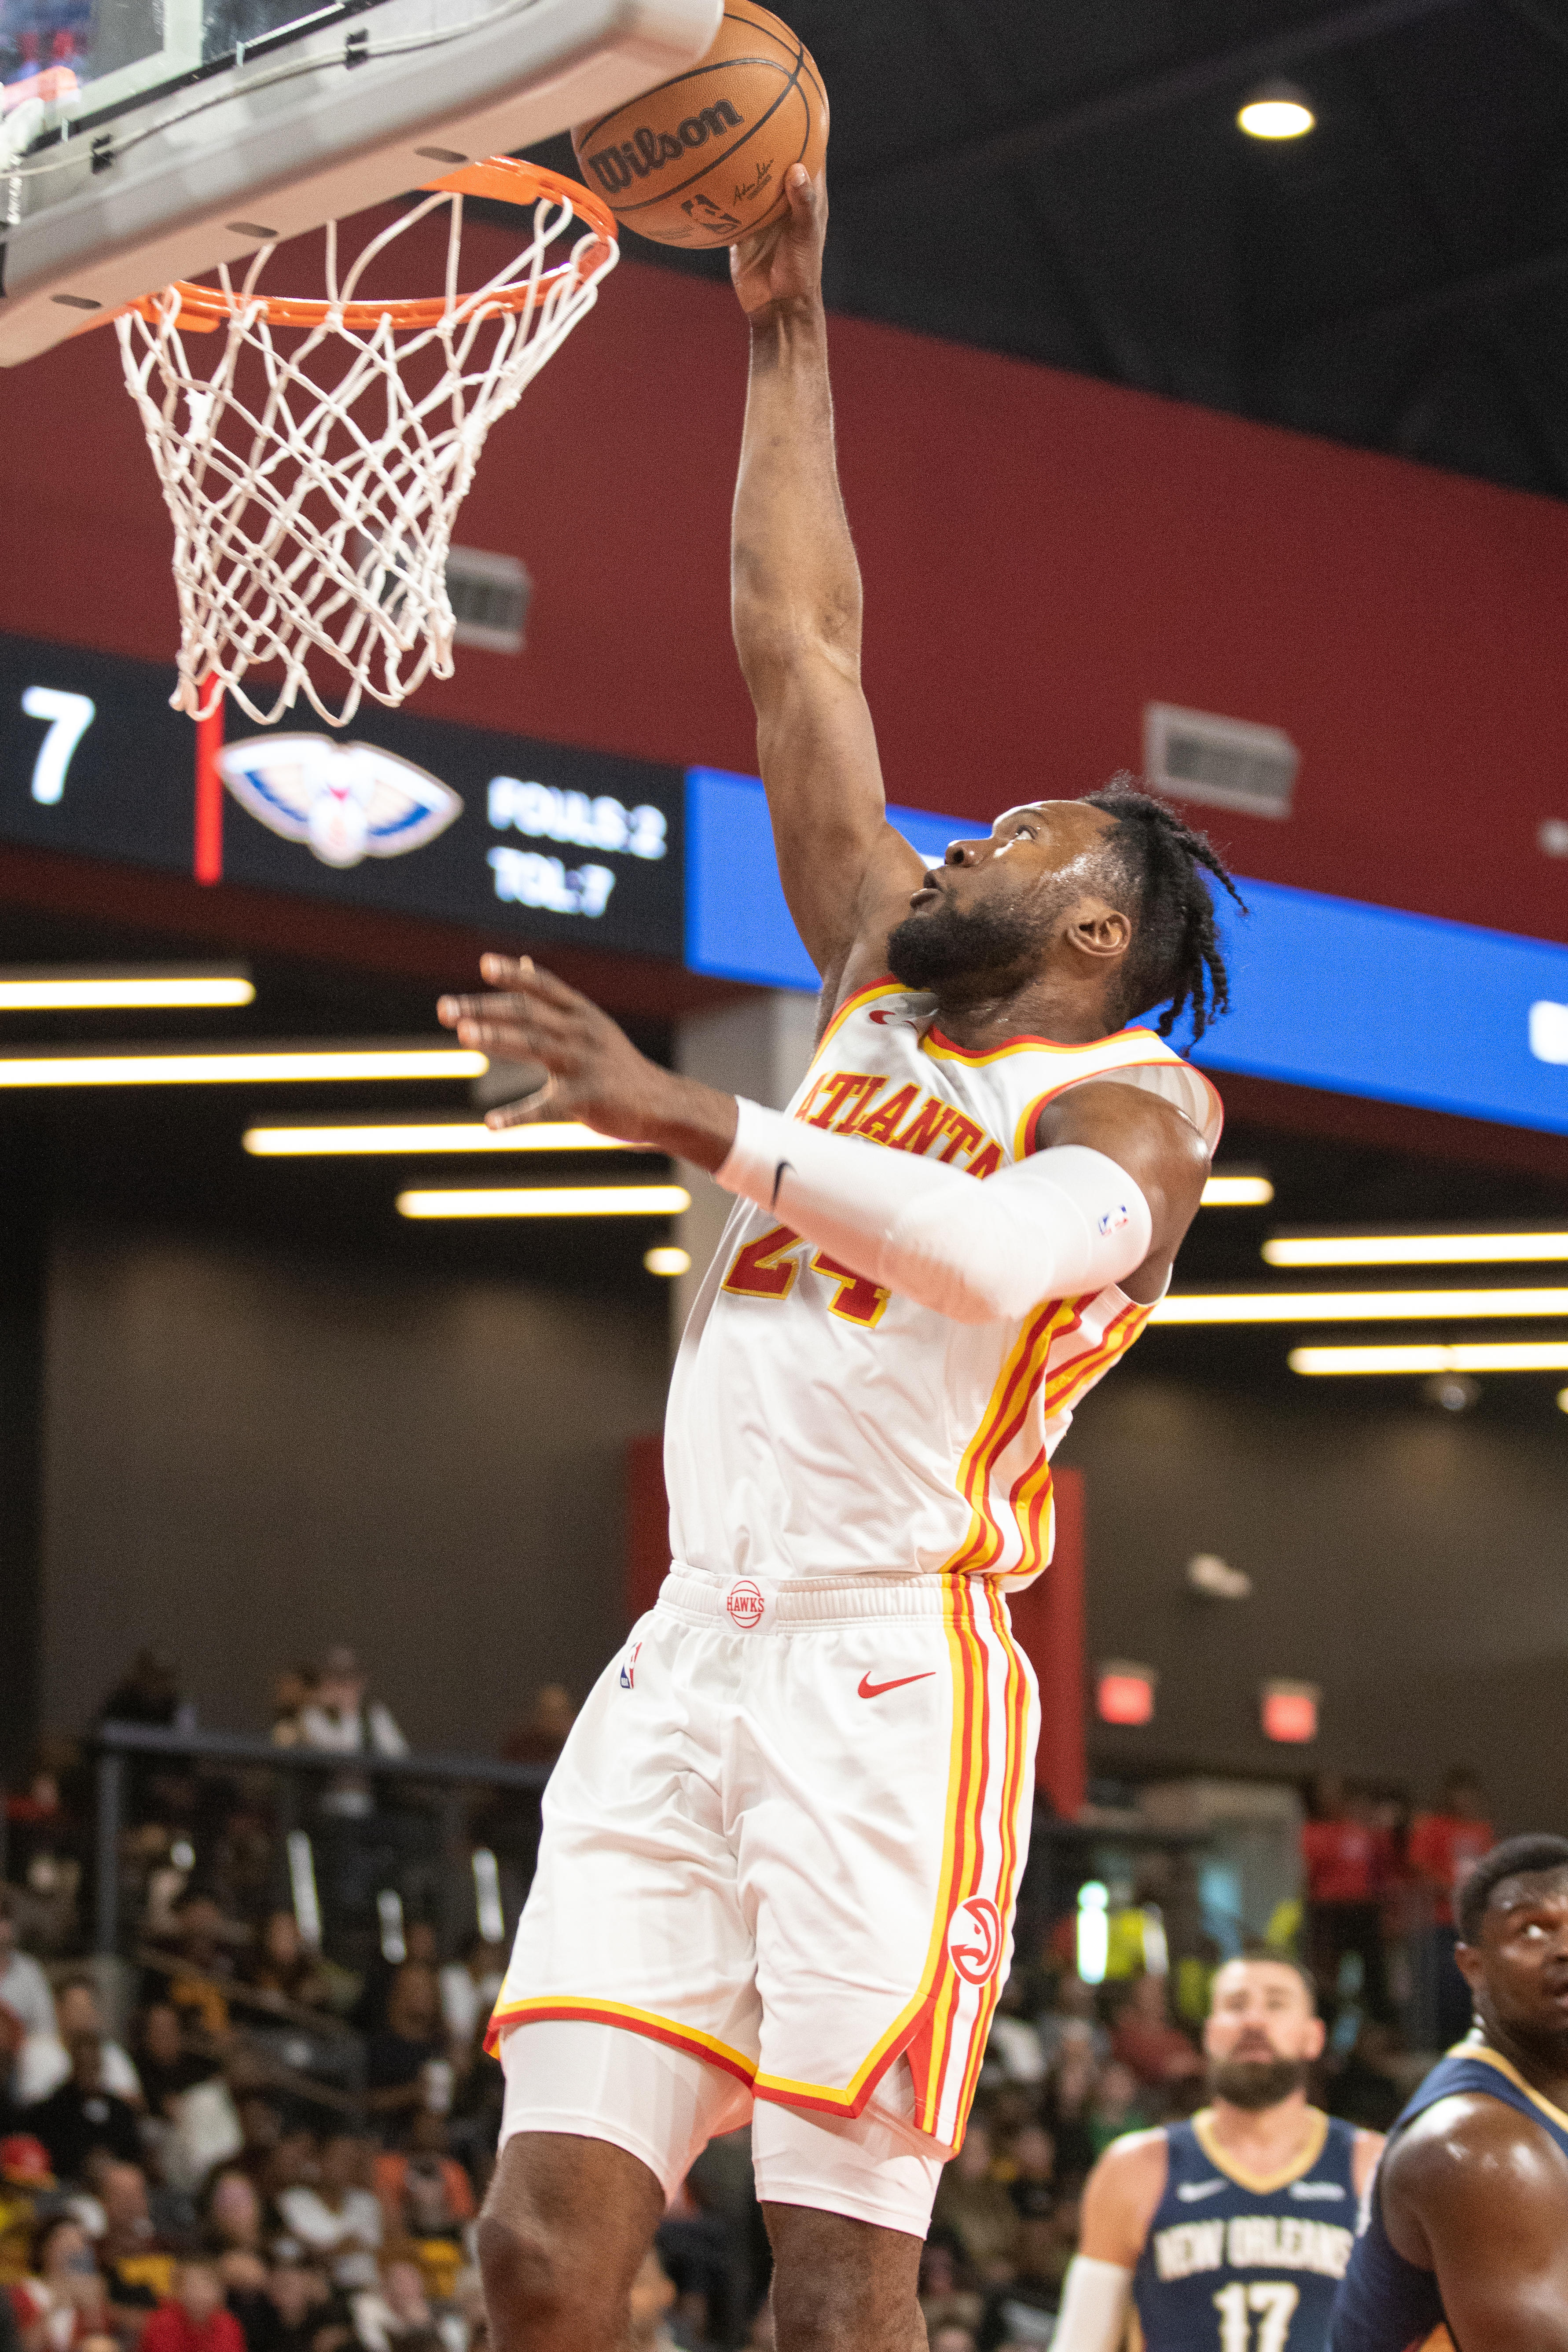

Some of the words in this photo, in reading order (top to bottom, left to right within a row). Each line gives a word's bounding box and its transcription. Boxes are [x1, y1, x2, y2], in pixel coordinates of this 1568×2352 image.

[588, 99, 744, 194] Wilson
[22, 685, 95, 806] 7
[793, 1070, 1004, 1181] ATLANTA
[727, 1596, 764, 1612] HAWKS
[1154, 2219, 1223, 2283] NEW
[1227, 2215, 1354, 2280] ORLEANS
[1212, 2281, 1300, 2352] 17
